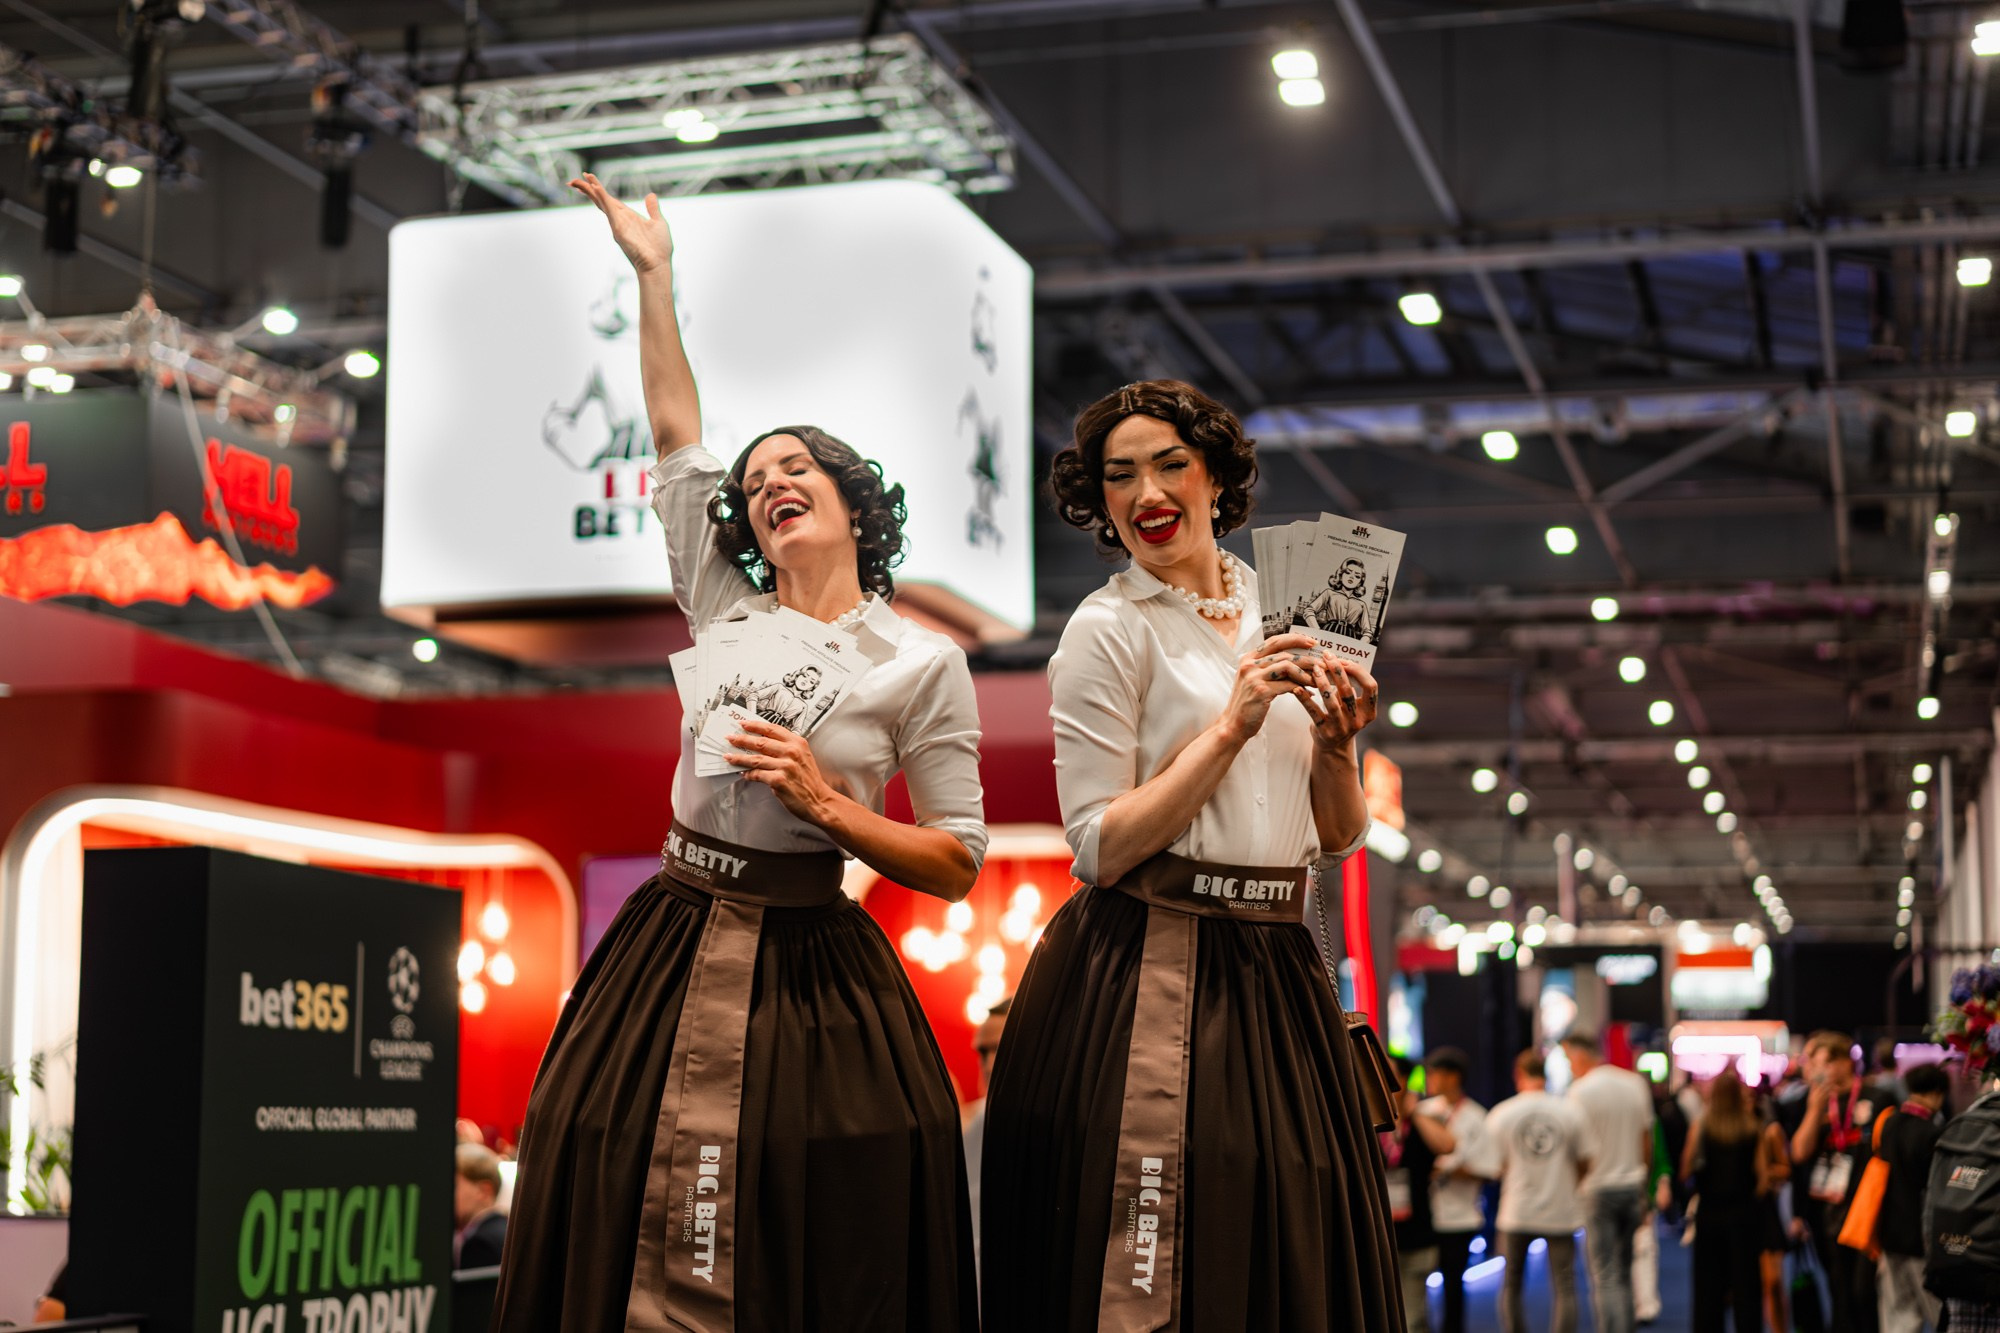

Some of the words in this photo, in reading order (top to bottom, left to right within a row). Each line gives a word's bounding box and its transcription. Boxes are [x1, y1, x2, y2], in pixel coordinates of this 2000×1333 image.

[1320, 640, 1333, 649] US
[1336, 643, 1370, 658] TODAY
[674, 859, 712, 880] PARTNERS
[684, 842, 748, 878] BETTY
[1193, 874, 1239, 899] BIG
[1242, 879, 1296, 901] BETTY
[1228, 900, 1271, 911] PARTNERS
[240, 971, 349, 1033] bet365
[256, 1106, 314, 1131] OFFICIAL
[315, 1106, 363, 1131] GLOBAL
[364, 1106, 417, 1131] PARTNER
[696, 1145, 721, 1195] BIG
[1139, 1157, 1163, 1206] BIG
[683, 1186, 695, 1243] PARTNERS
[1124, 1197, 1137, 1253] PARTNERS
[238, 1184, 422, 1300] OFFICIAL
[692, 1202, 717, 1284] BETTY
[1131, 1213, 1159, 1295] BETTY
